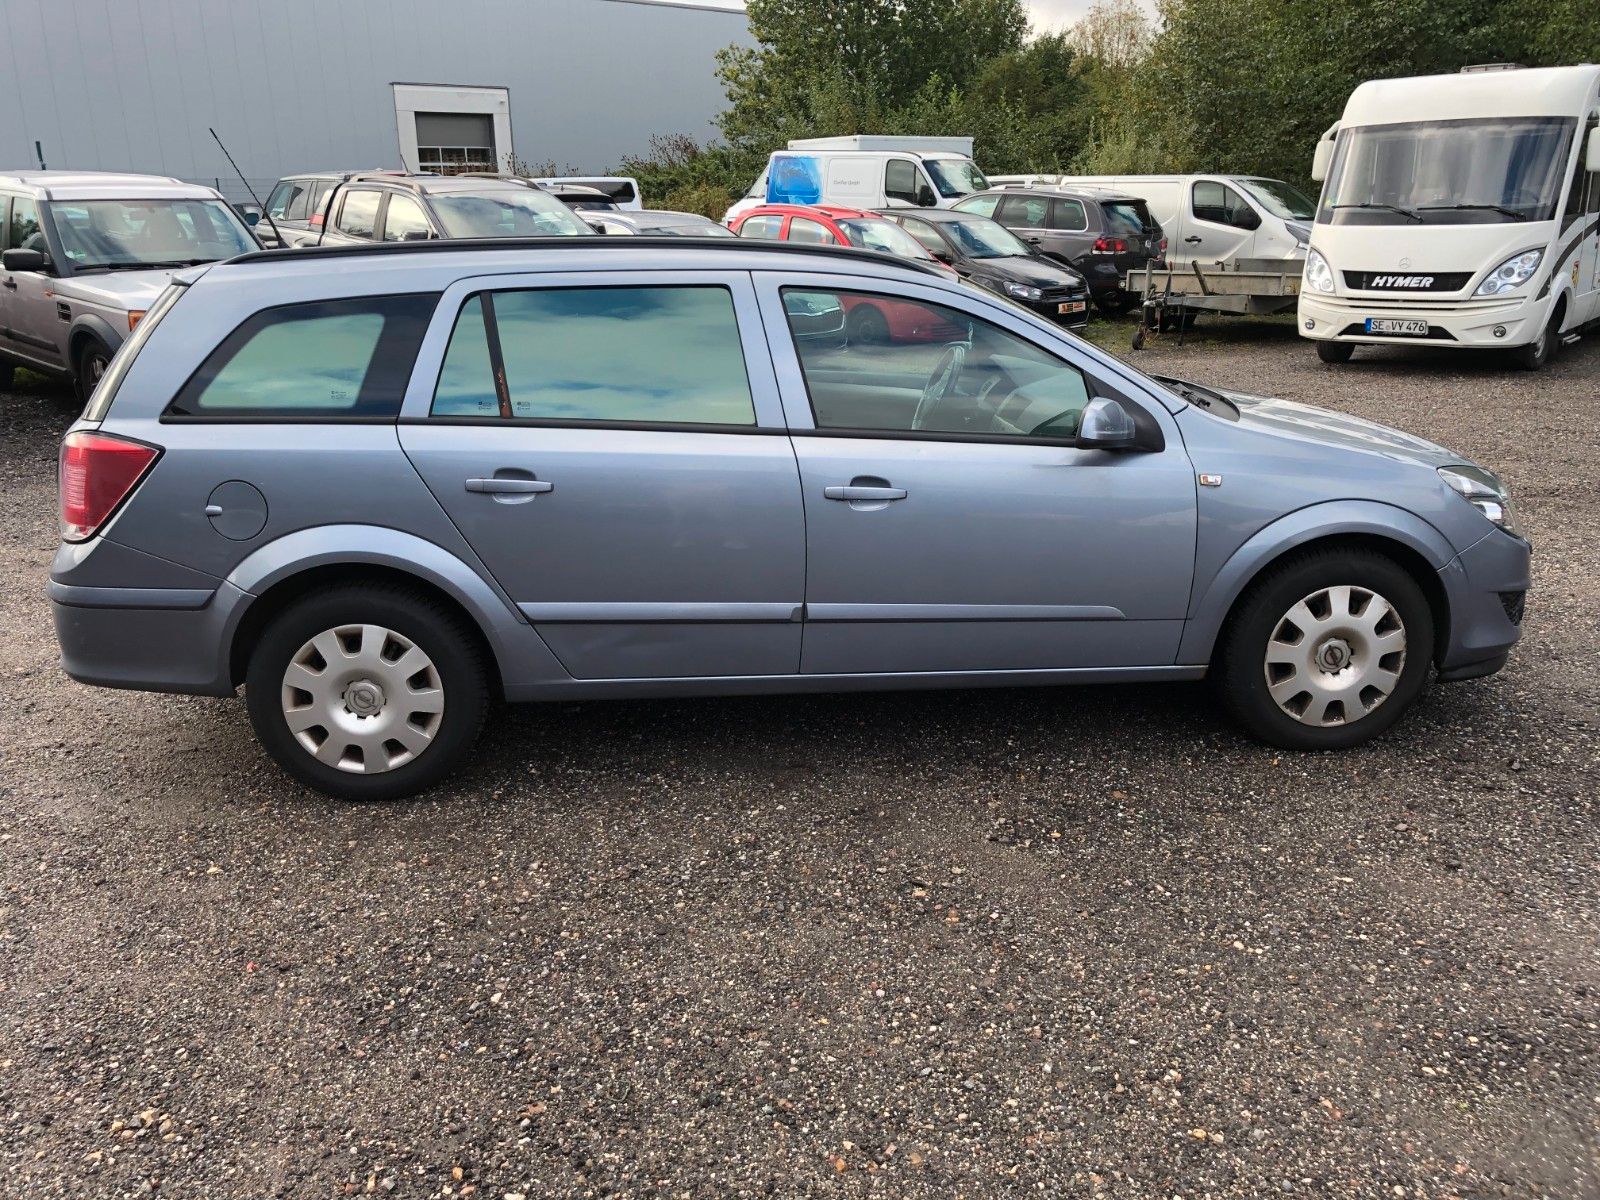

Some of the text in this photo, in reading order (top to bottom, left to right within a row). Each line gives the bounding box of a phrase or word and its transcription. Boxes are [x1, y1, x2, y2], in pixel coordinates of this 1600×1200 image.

[1371, 275, 1434, 288] HYMER
[1371, 320, 1425, 332] SE VY 476
